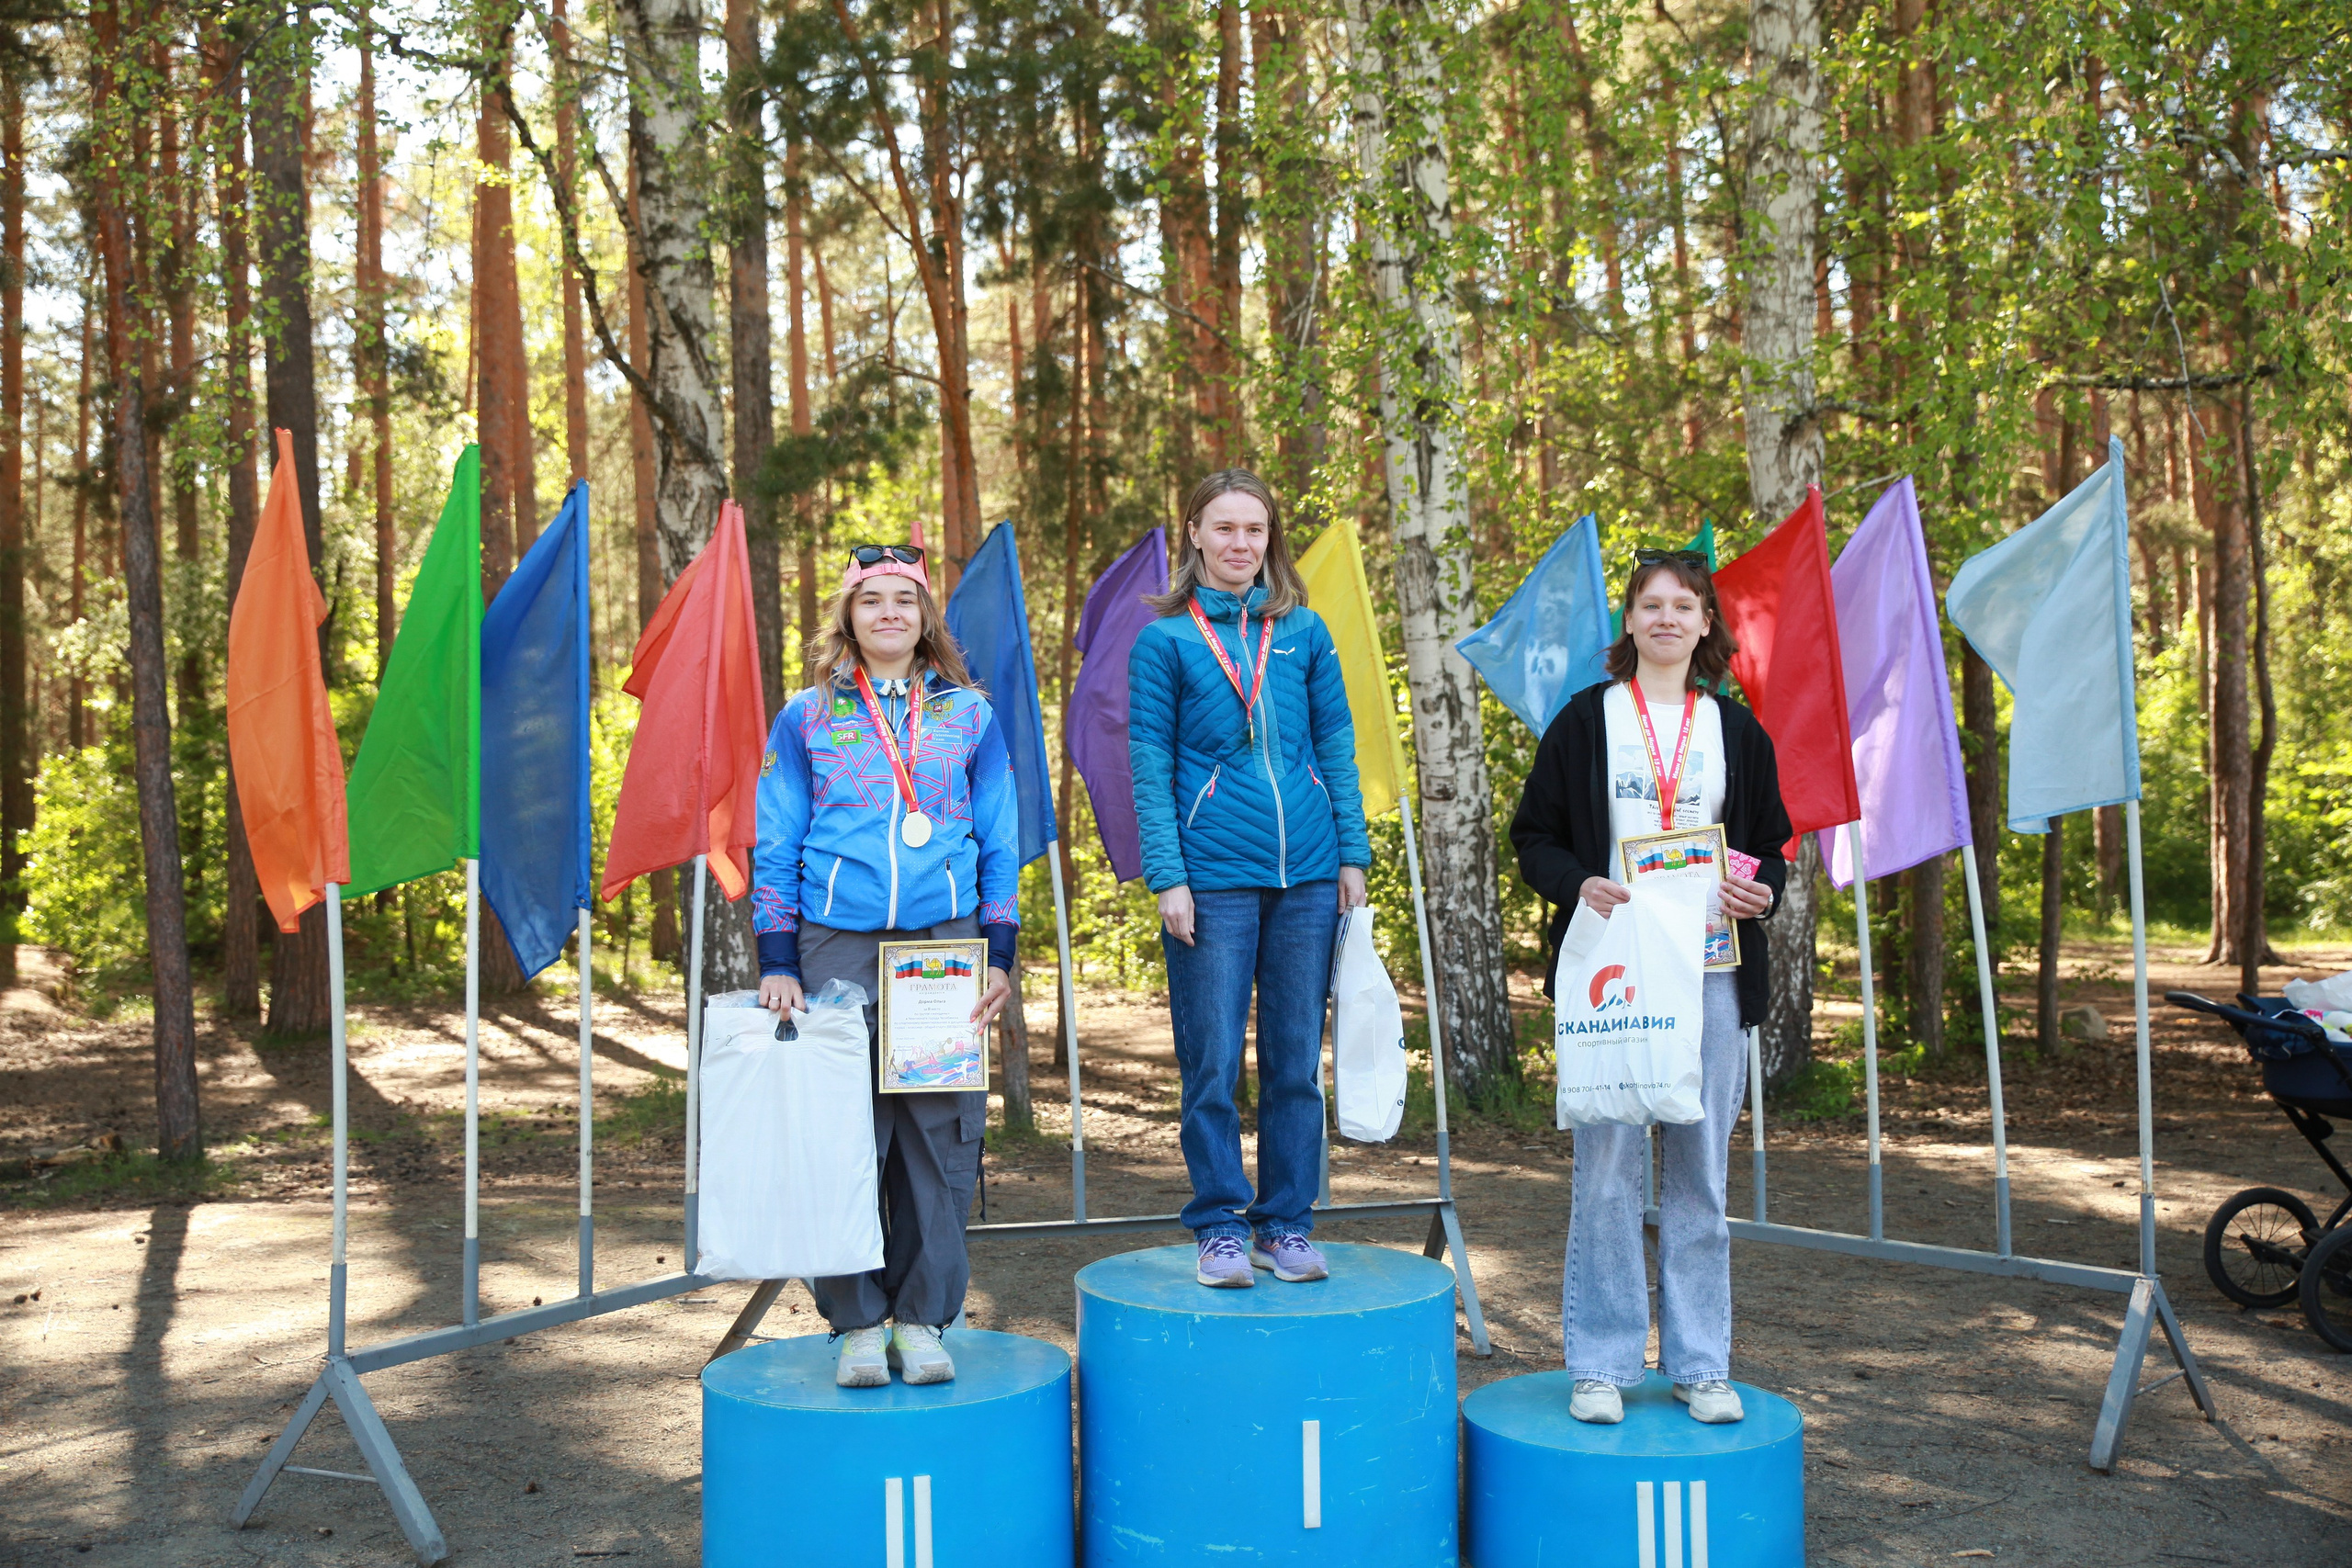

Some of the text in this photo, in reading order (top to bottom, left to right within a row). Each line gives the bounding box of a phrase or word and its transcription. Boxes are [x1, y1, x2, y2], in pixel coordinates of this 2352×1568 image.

[1198, 616, 1208, 631] Иван
[1211, 638, 1223, 655] Марья
[877, 717, 887, 736] Марья
[889, 746, 897, 761] Иван
[1648, 737, 1657, 756] Марья
[1672, 763, 1680, 779] Иван
[1678, 736, 1687, 754] Марья
[1558, 1016, 1675, 1035] СКАНДИНАВИЯ
